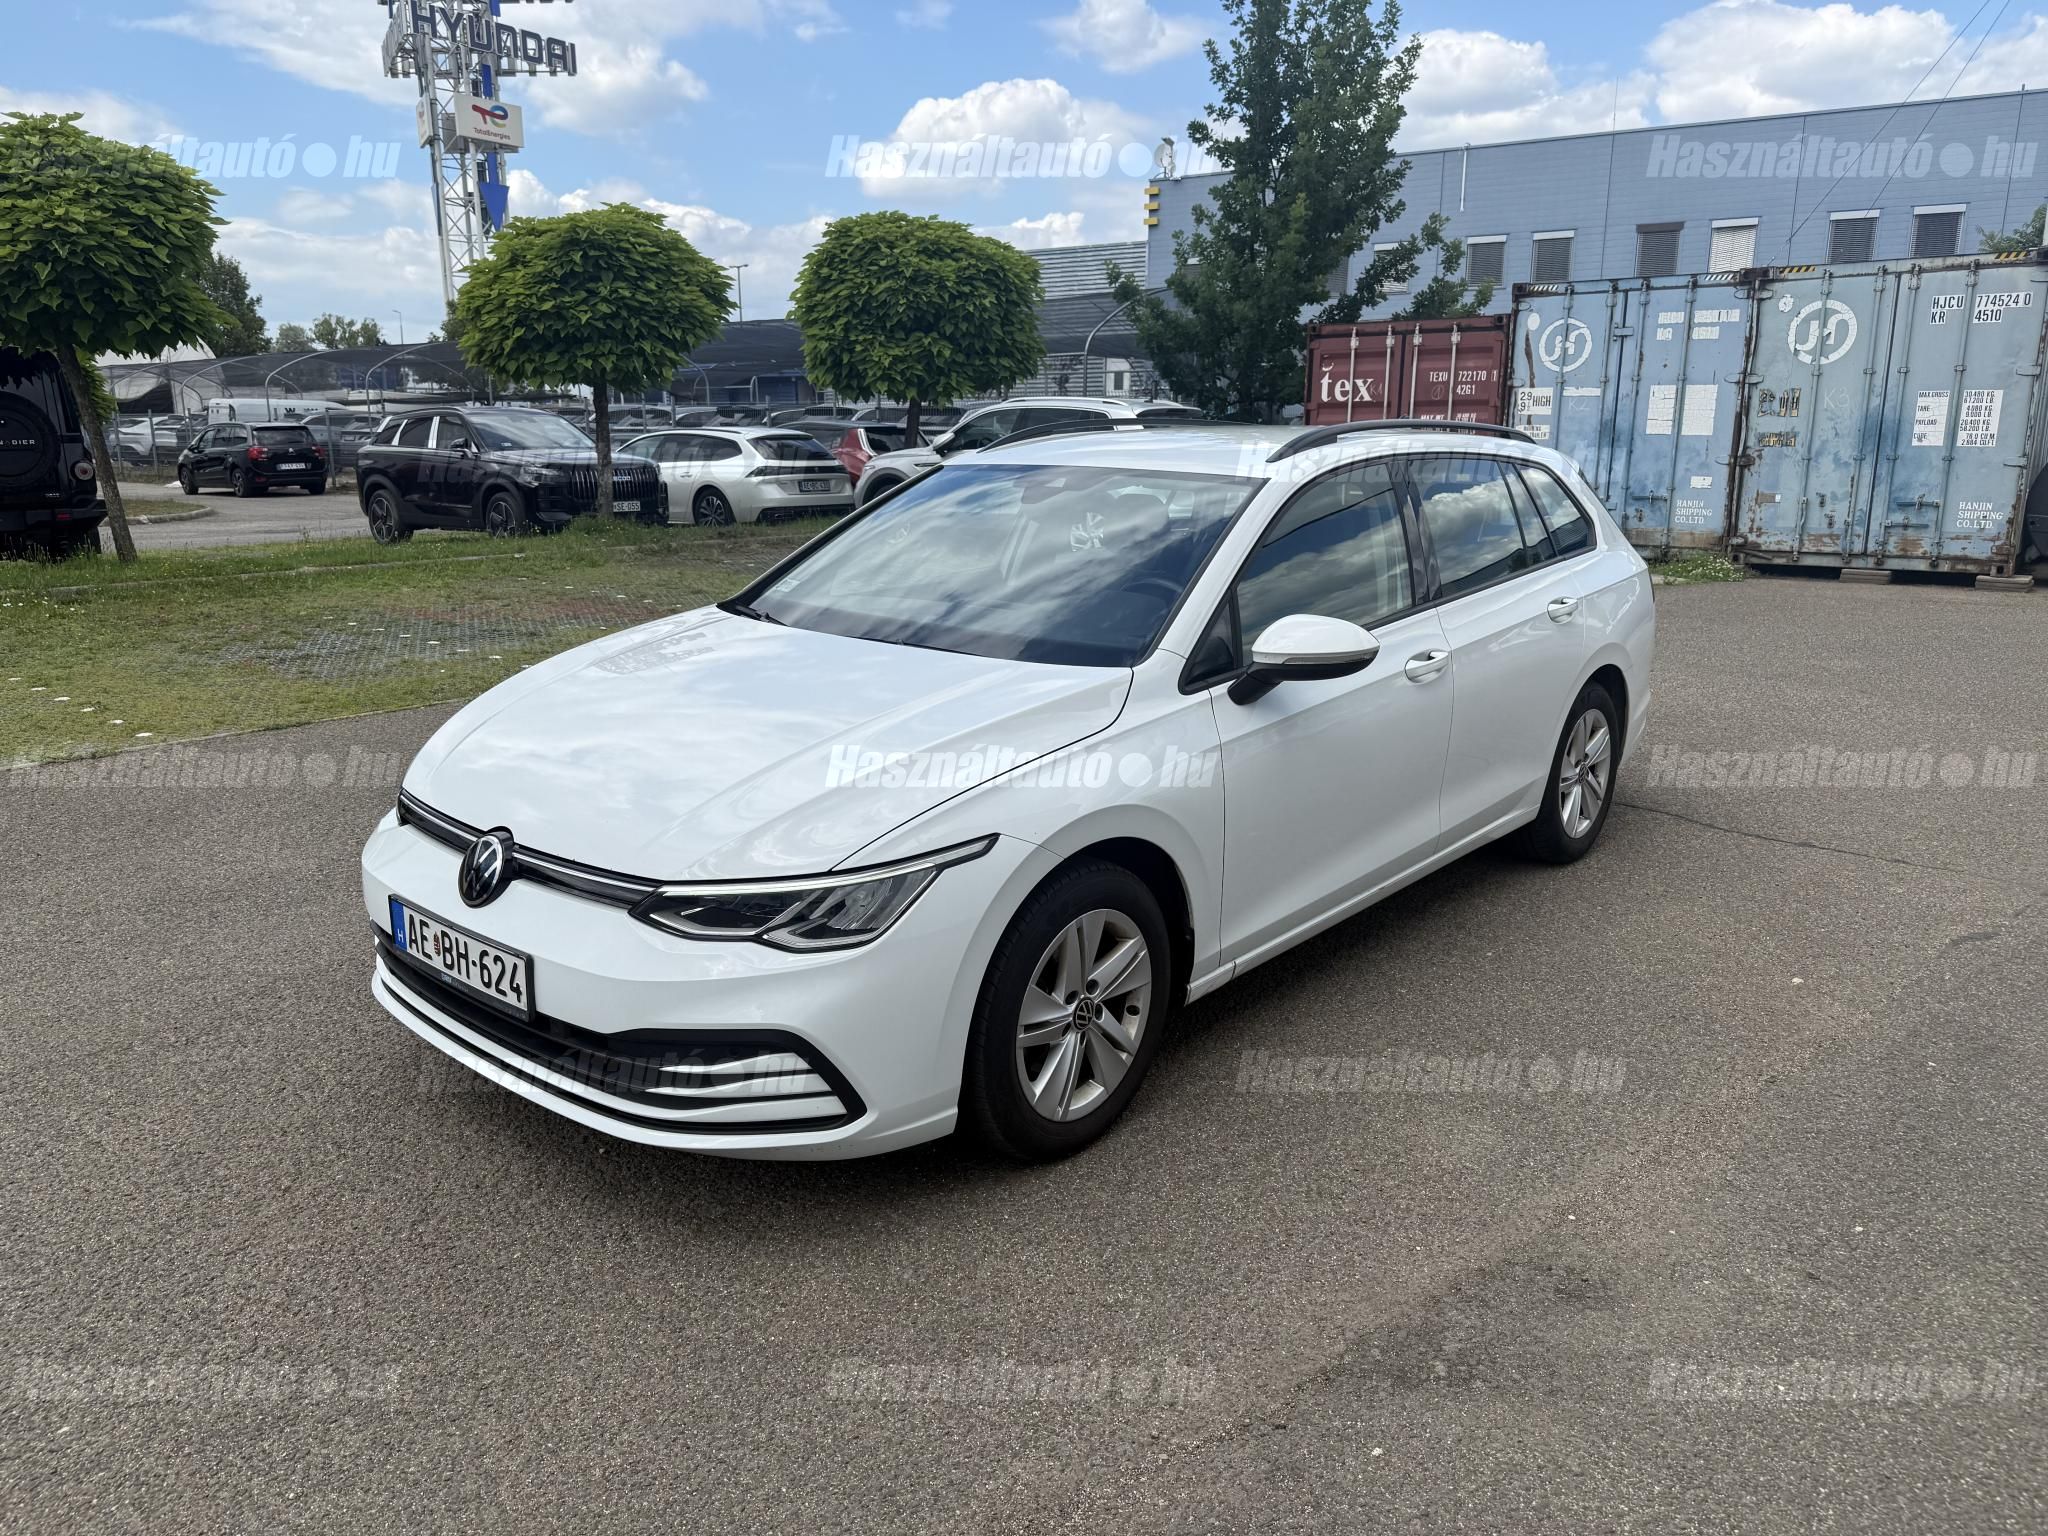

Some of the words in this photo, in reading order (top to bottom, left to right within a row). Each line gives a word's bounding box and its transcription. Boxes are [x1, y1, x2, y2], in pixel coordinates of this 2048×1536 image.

[411, 0, 578, 75] HYUNDAI
[474, 127, 511, 140] TotalEnergies
[1932, 295, 1964, 309] HJCU
[1977, 294, 2020, 308] 774524
[2024, 292, 2032, 306] 0
[1930, 311, 1945, 323] KR
[1974, 309, 2002, 322] 4510
[1430, 371, 1448, 382] TEXU
[1458, 370, 1487, 381] 722170
[1456, 384, 1475, 395] 42G1
[1532, 395, 1551, 407] HIGH
[1677, 499, 1704, 508] HANJIN
[1960, 501, 1993, 510] HANJIN
[1676, 507, 1713, 516] SHIPPING
[1958, 510, 2004, 520] SHIPPING
[397, 928, 404, 943] H
